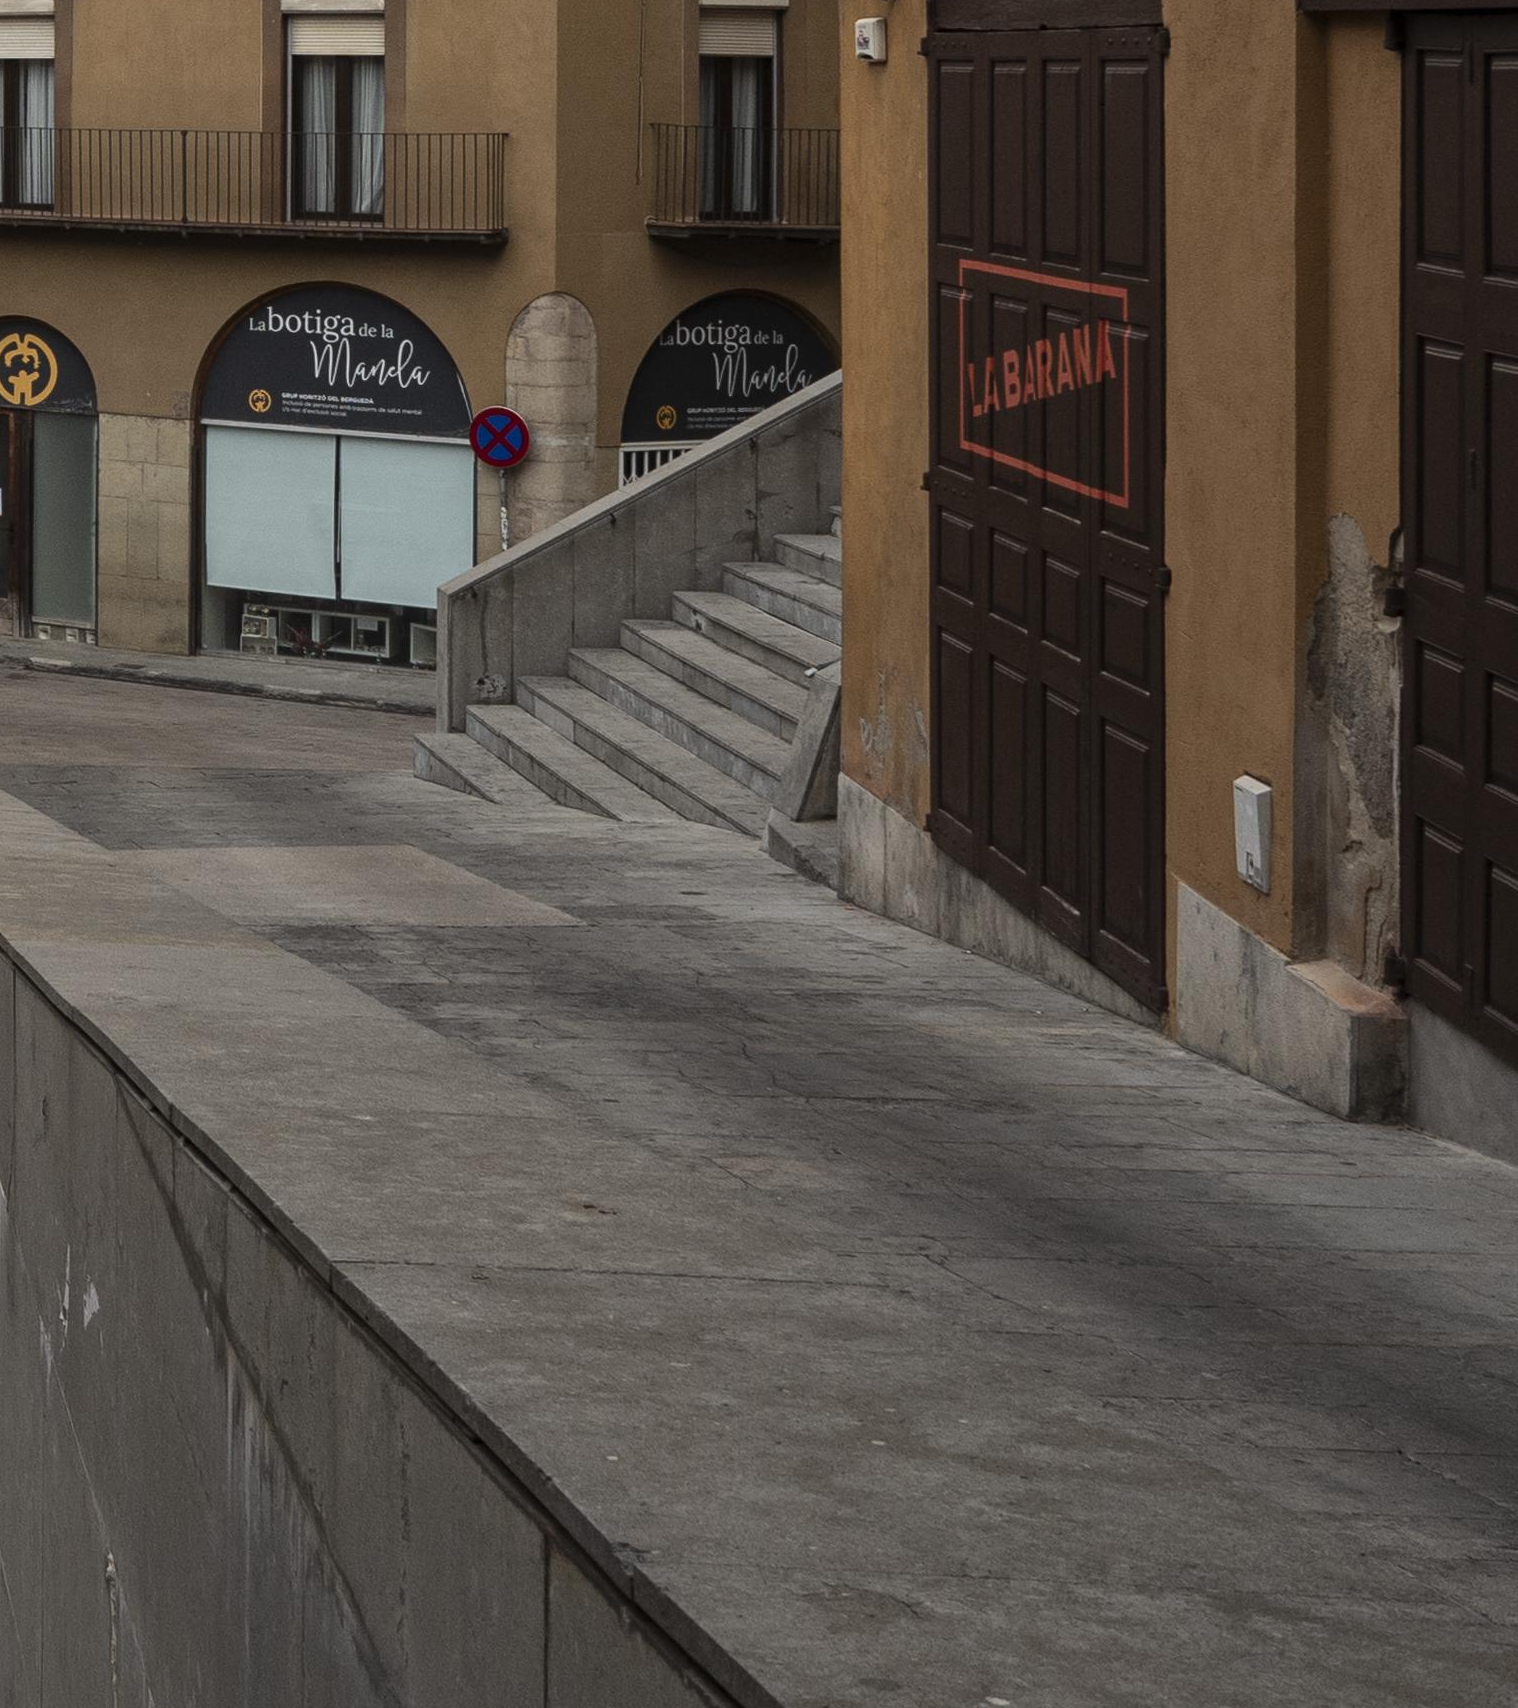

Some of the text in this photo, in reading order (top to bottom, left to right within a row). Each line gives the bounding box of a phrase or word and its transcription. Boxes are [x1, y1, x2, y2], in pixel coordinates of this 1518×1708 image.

[249, 306, 394, 343] La botiga de la
[676, 320, 751, 353] botiga
[754, 331, 770, 345] de
[773, 330, 784, 345] la
[310, 337, 431, 389] Manela
[713, 344, 812, 397] Manela
[968, 319, 1116, 417] LA BARANA
